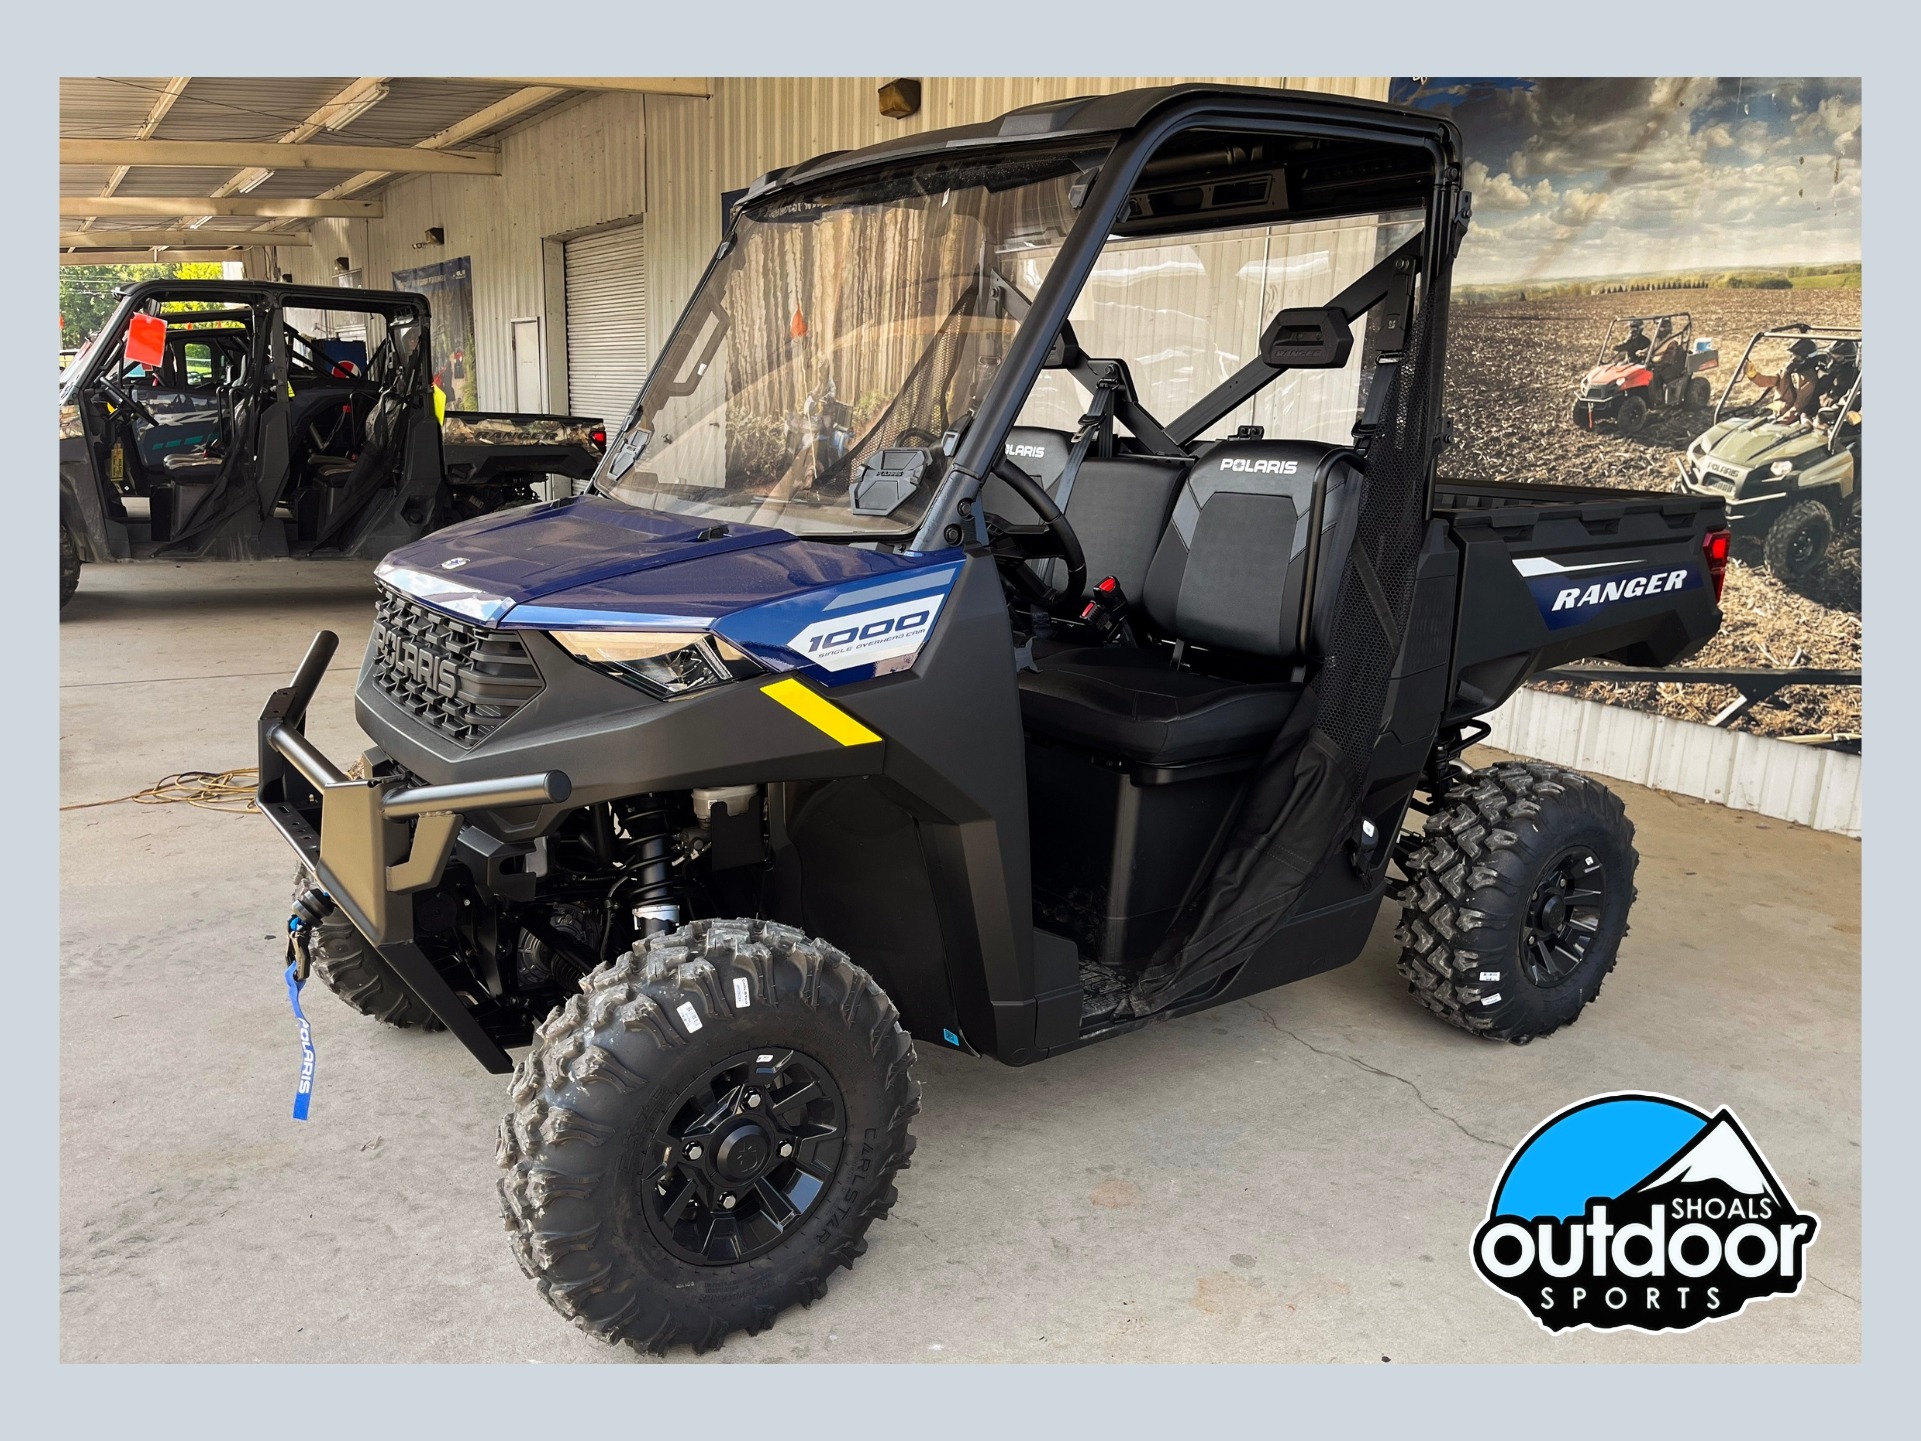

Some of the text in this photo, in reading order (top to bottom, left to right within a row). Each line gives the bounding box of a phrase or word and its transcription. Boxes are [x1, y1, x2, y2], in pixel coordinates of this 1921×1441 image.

[474, 431, 559, 441] RANGER
[1219, 458, 1298, 475] POLARIS
[1707, 461, 1741, 478] POLARIS
[1551, 569, 1688, 612] RANGER
[808, 610, 930, 653] 1000
[818, 628, 926, 658] SINGLE OVERHEAD CAM
[374, 620, 457, 699] POLARIS
[298, 1017, 314, 1094] POLARIS
